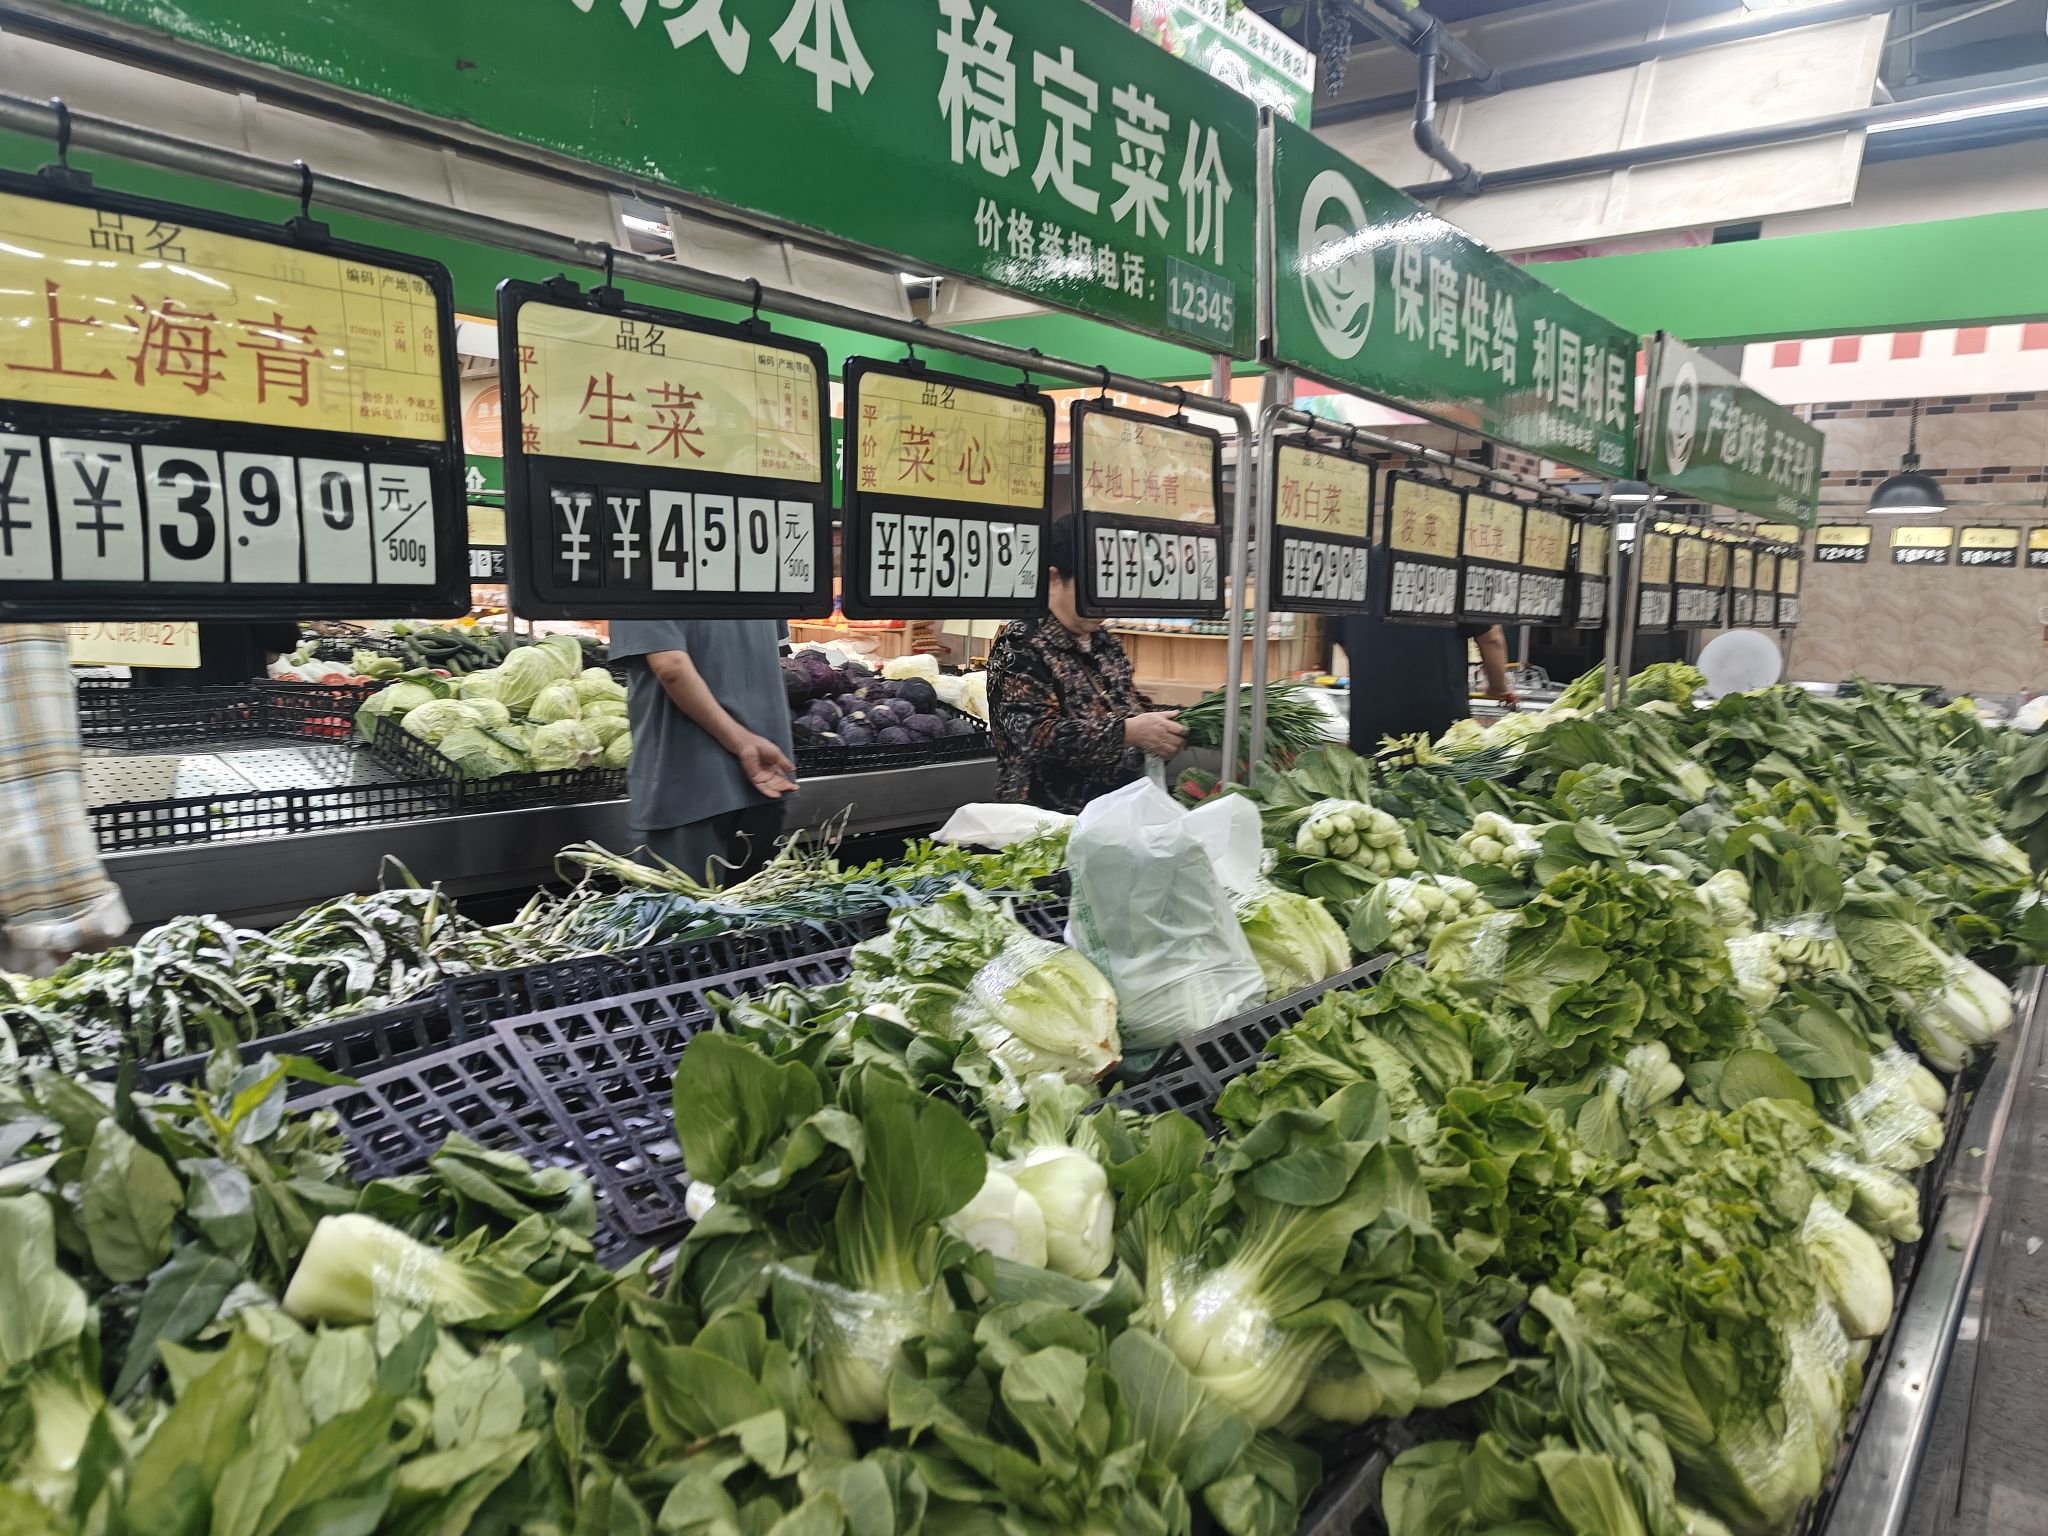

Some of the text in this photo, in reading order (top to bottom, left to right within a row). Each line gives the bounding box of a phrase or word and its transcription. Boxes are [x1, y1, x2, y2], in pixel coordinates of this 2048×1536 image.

[936, 0, 1233, 266] 稳定菜价
[89, 209, 186, 264] 品名
[382, 274, 409, 292] 产地
[1168, 276, 1233, 332] 12345
[6, 278, 326, 409] 上海青
[616, 319, 666, 357] 品名
[1390, 243, 1627, 432] 保障供给 利国利民
[578, 371, 706, 459] 生菜
[921, 381, 956, 410] 品名
[861, 404, 878, 488] 平价菜
[898, 424, 991, 486] 菜心
[1084, 461, 1180, 506] 本地上海青
[1281, 475, 1342, 526] 奶白菜
[379, 476, 428, 568] 元/500g
